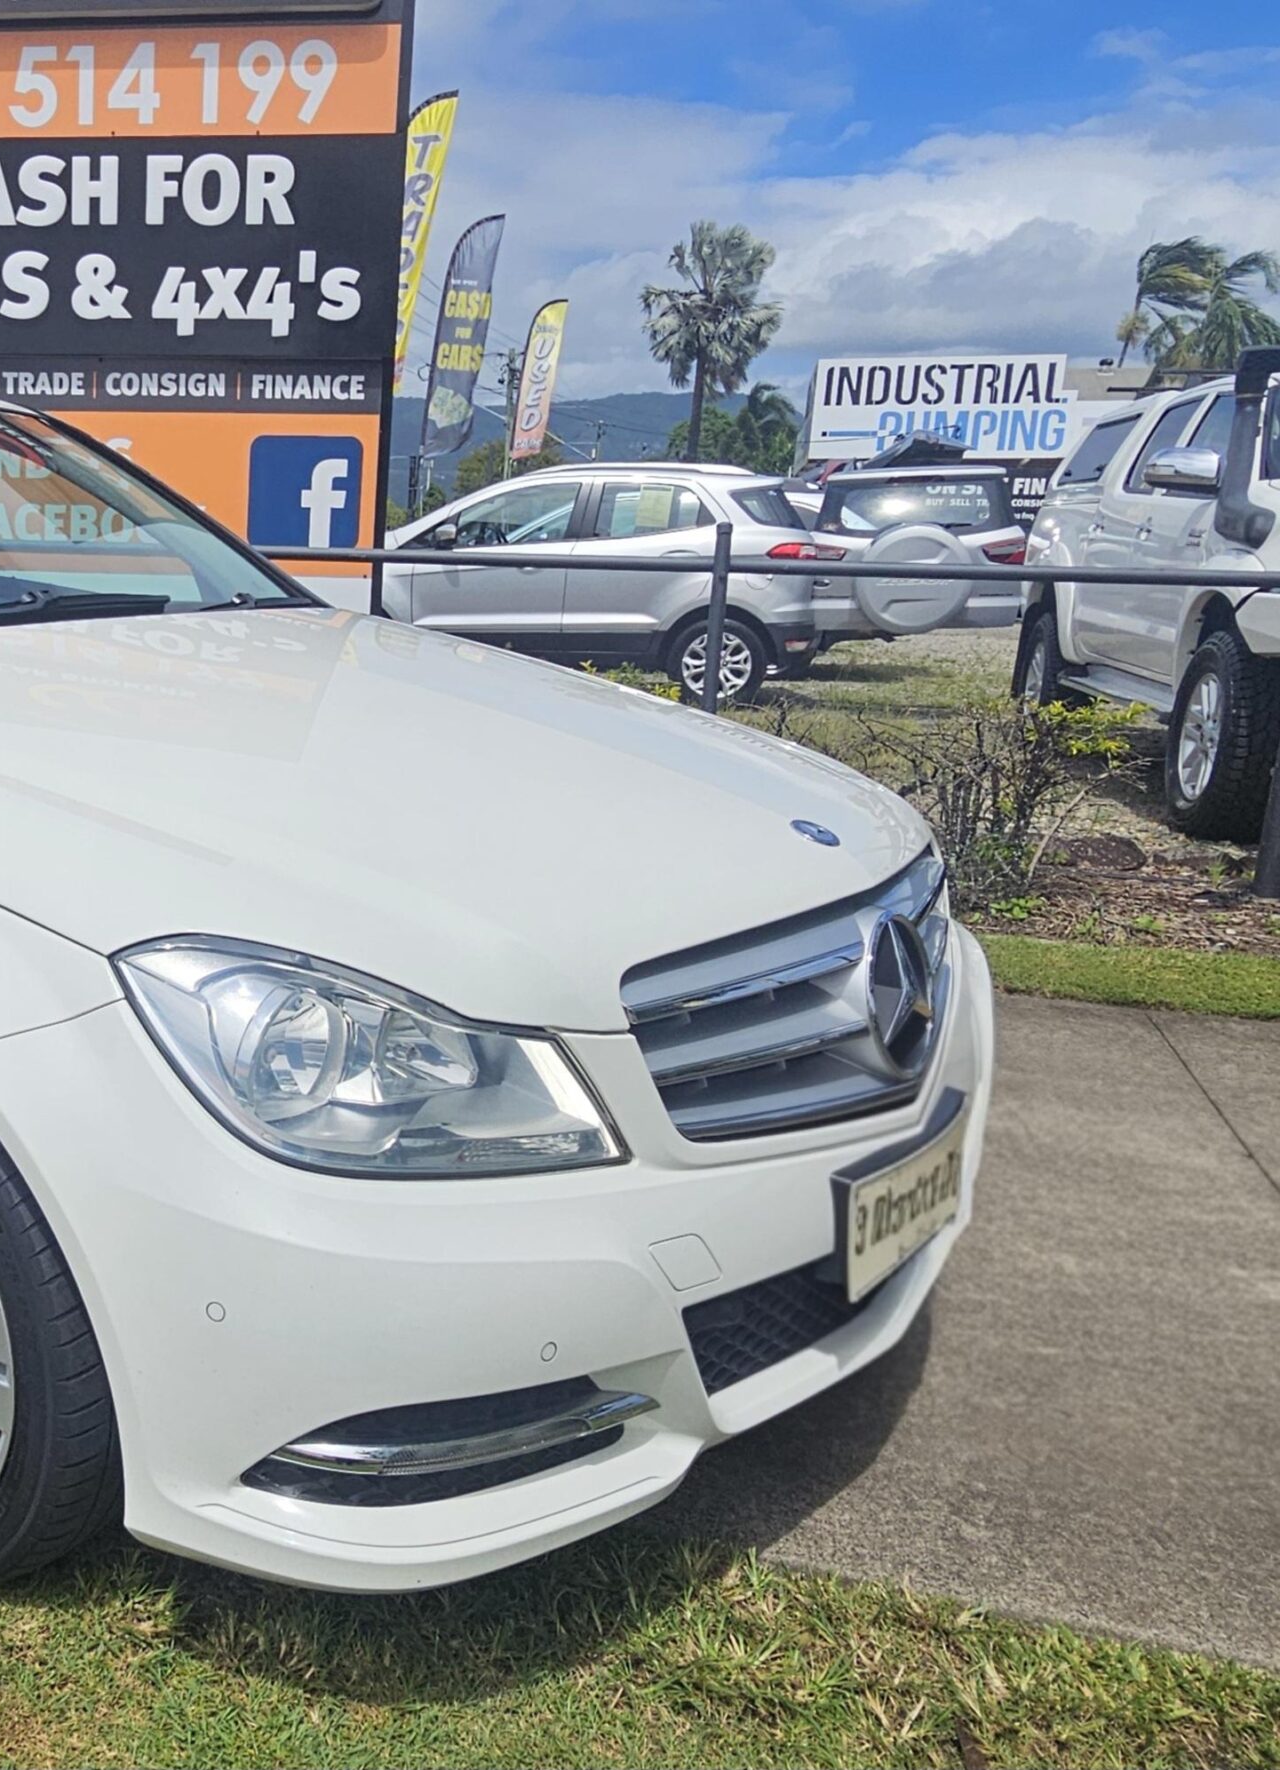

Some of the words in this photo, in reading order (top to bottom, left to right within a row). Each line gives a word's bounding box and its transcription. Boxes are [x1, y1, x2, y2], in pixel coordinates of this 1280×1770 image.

[8, 41, 161, 128] 514
[190, 39, 338, 125] 199
[145, 153, 295, 226] FOR
[71, 253, 132, 320] &
[2, 372, 85, 396] TRADE
[105, 372, 226, 397] CONSIGN
[251, 374, 365, 400] FINANCE
[521, 336, 555, 432] USED
[823, 362, 1064, 406] INDUSTRIAL
[876, 410, 1067, 452] PUMPING
[1012, 478, 1047, 495] FIN
